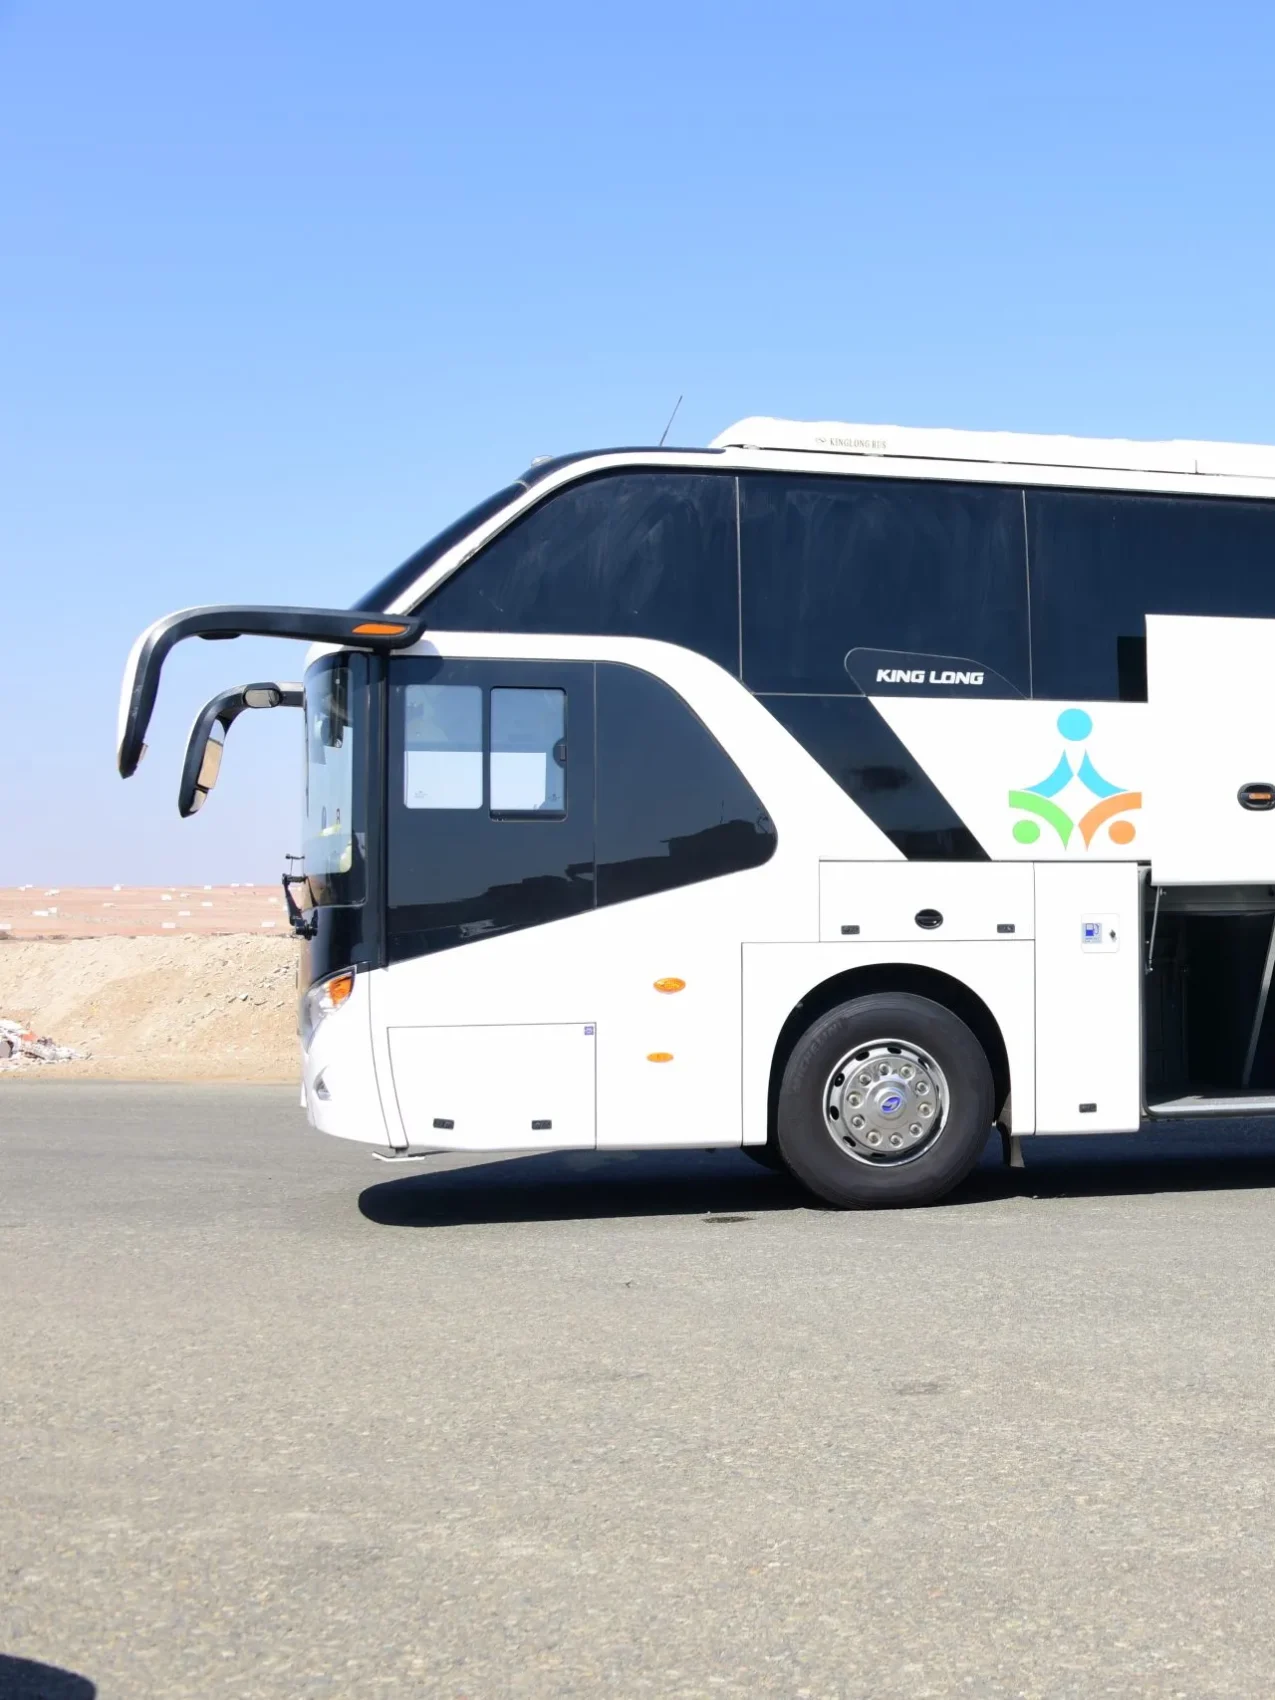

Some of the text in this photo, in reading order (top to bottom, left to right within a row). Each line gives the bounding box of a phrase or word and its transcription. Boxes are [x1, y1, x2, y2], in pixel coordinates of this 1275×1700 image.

[830, 437, 870, 448] KINGLONG
[876, 669, 984, 685] KING LONG
